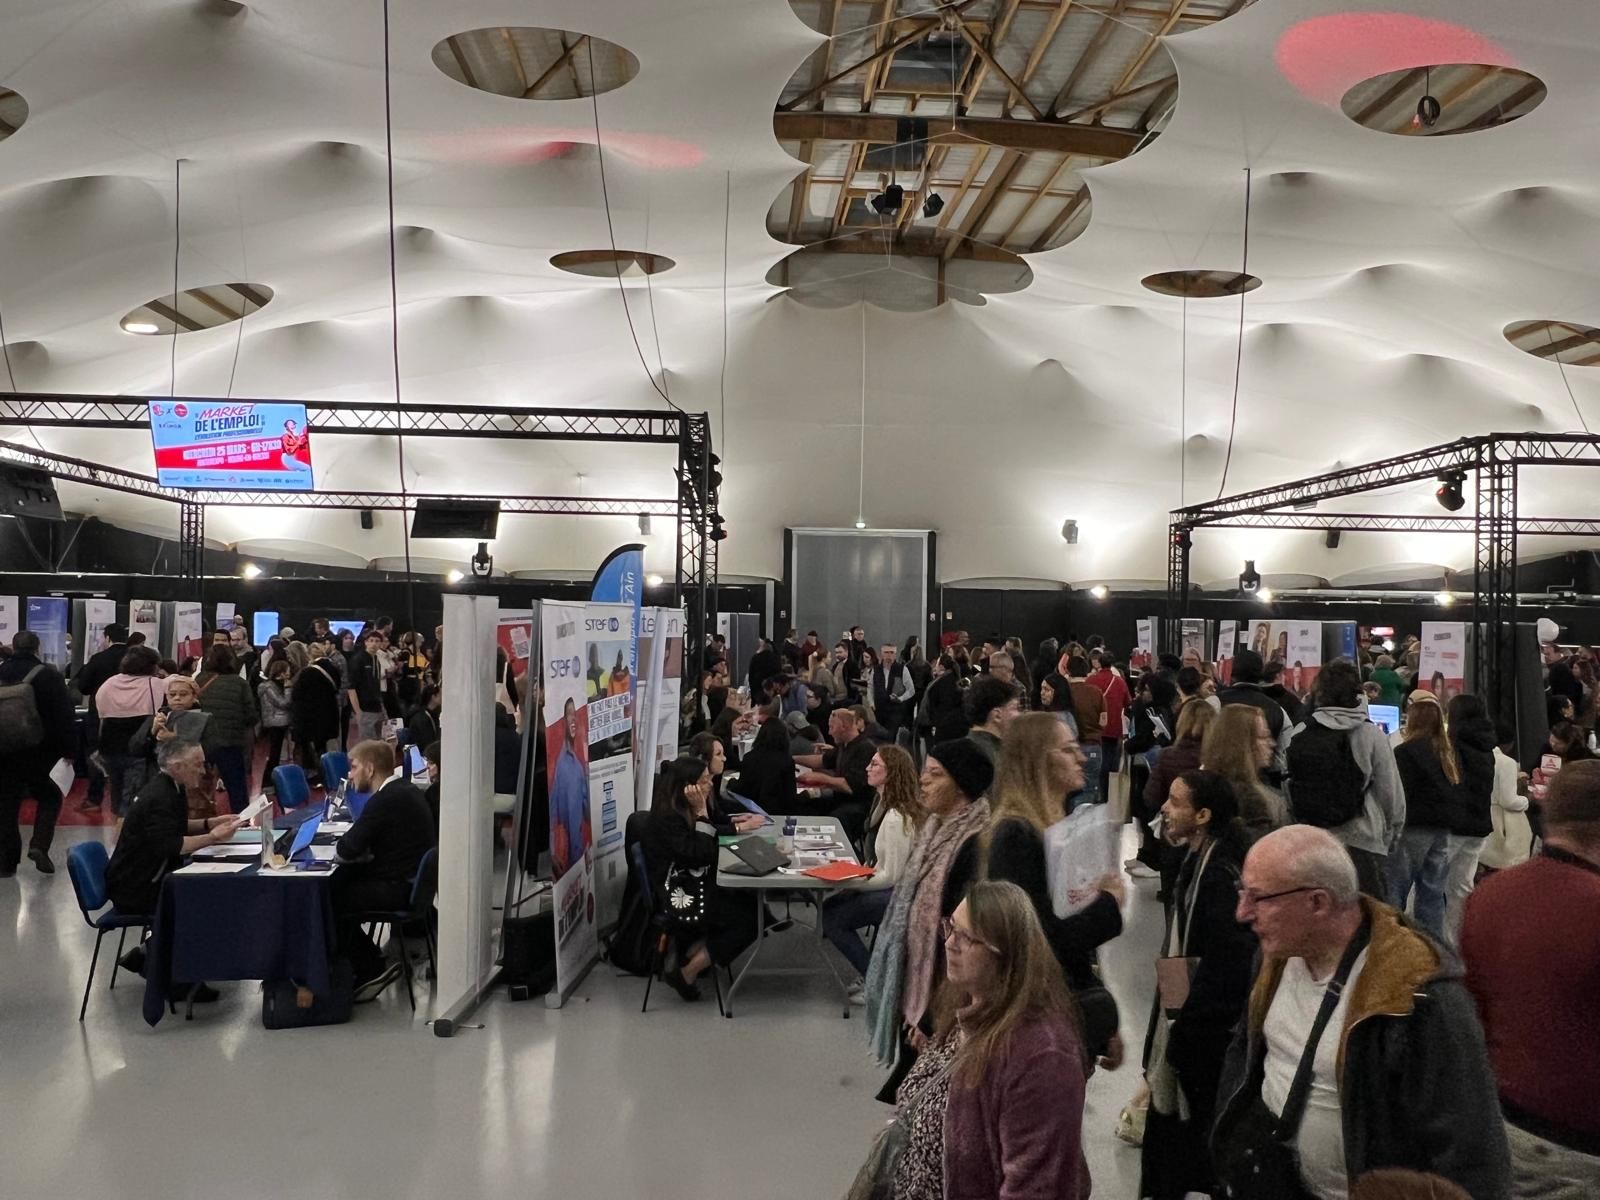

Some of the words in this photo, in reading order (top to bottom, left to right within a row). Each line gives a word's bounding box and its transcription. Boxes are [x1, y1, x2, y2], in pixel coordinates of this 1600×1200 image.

[199, 403, 256, 420] MARKET
[195, 420, 208, 433] DE
[211, 414, 259, 431] L'EMPLOI
[624, 571, 635, 594] Ain
